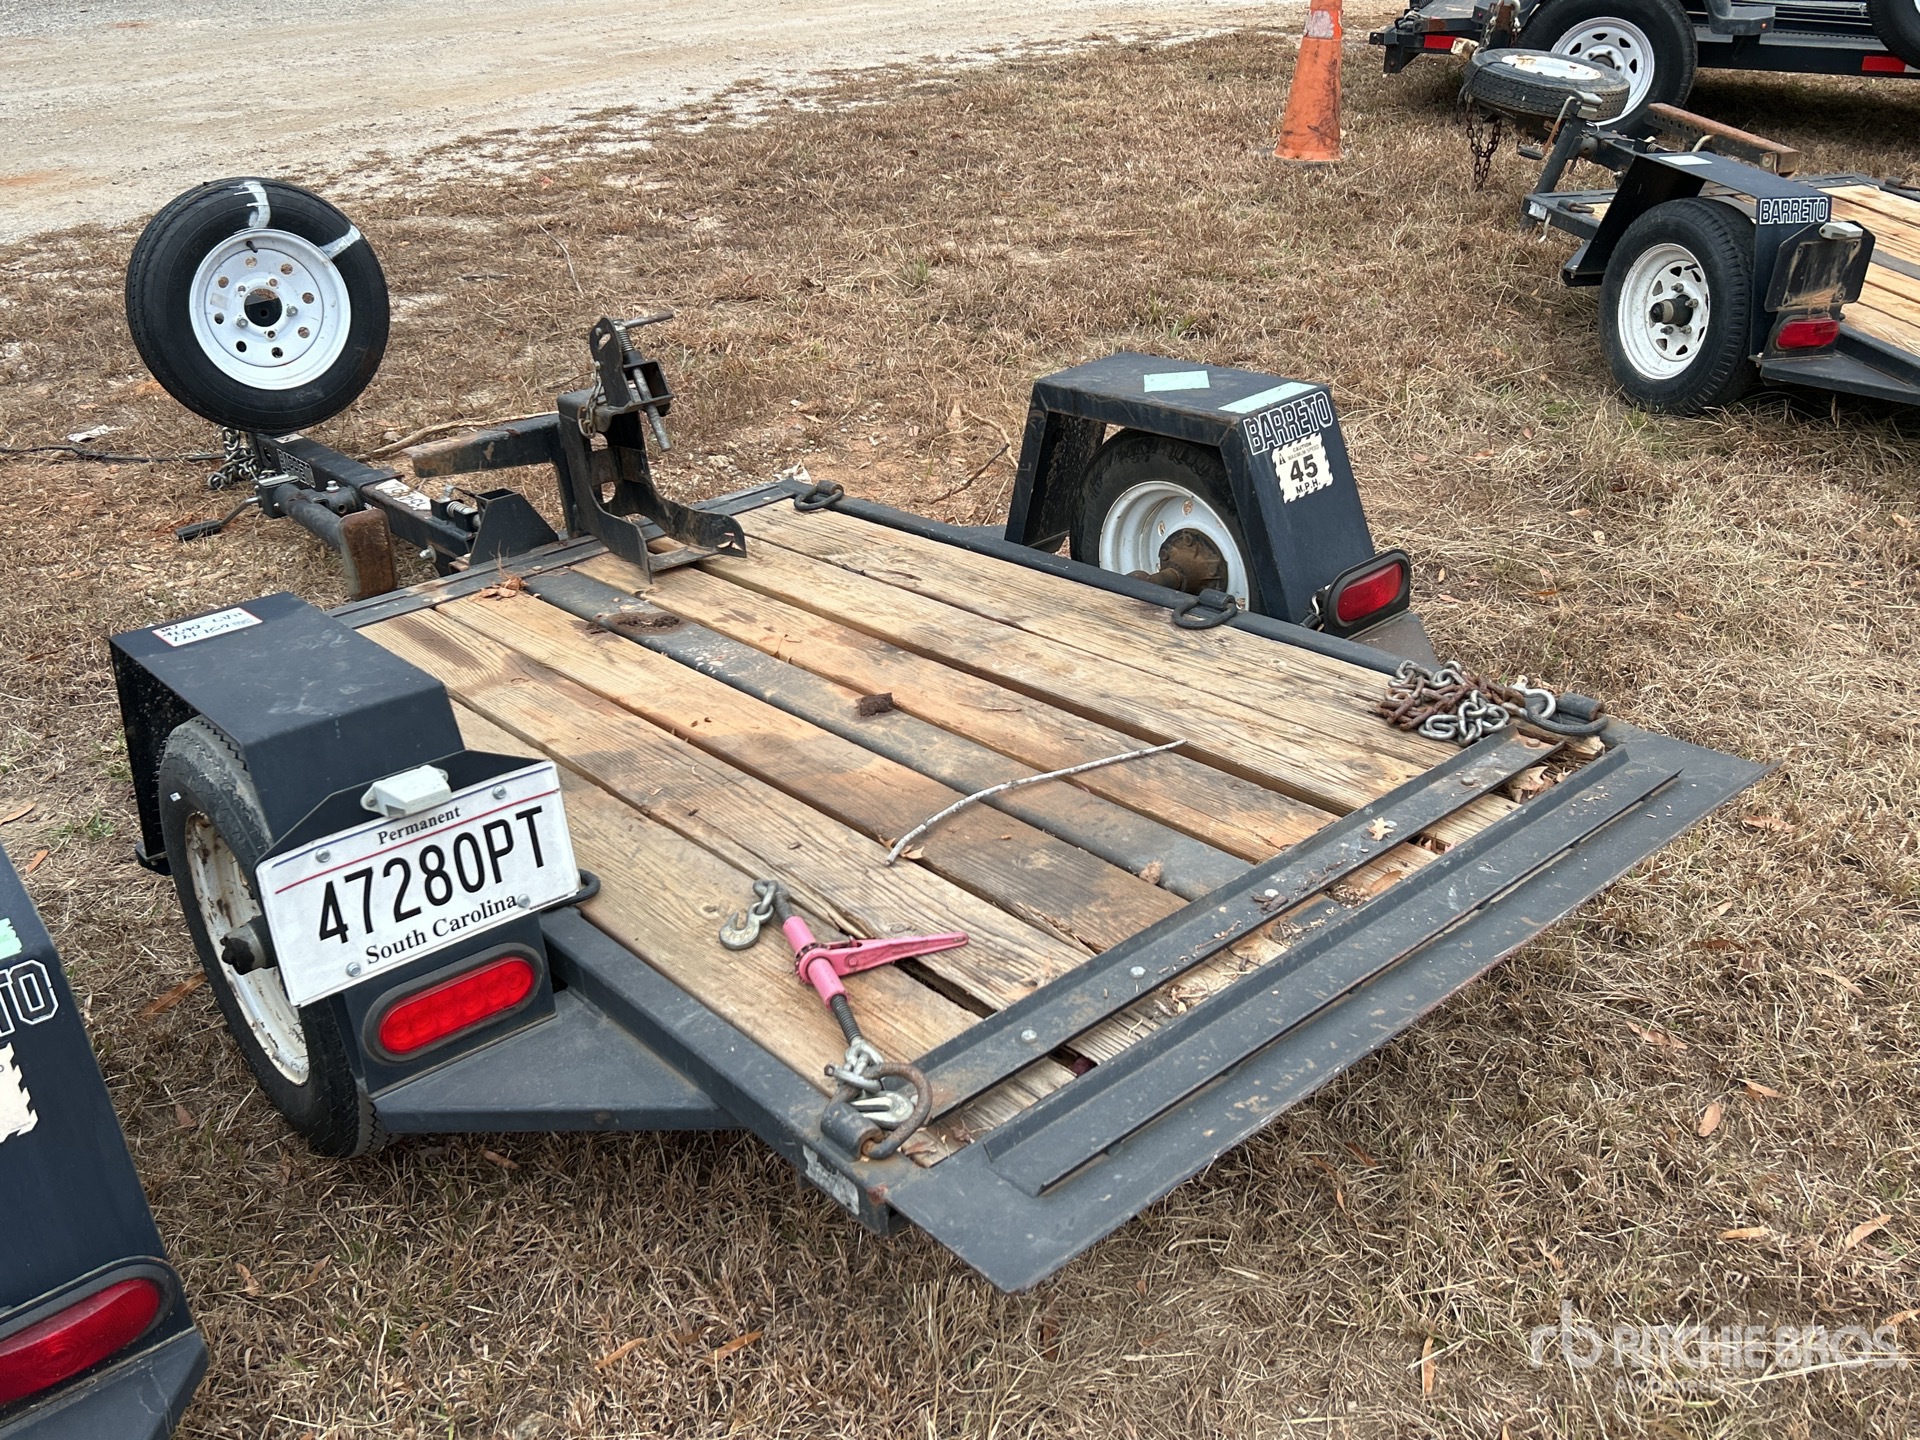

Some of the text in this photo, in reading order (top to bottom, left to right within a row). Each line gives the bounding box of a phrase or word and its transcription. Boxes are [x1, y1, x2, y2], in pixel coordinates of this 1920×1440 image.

[1759, 196, 1829, 225] BARRETO
[1243, 391, 1333, 456] BARRETO
[1292, 441, 1312, 453] CAUTION
[1290, 453, 1318, 483] 45
[1295, 478, 1321, 495] M.P.H.
[377, 805, 462, 845] Permanent
[318, 805, 545, 945] 47280PT
[366, 928, 427, 965] South
[432, 894, 518, 938] Carolina
